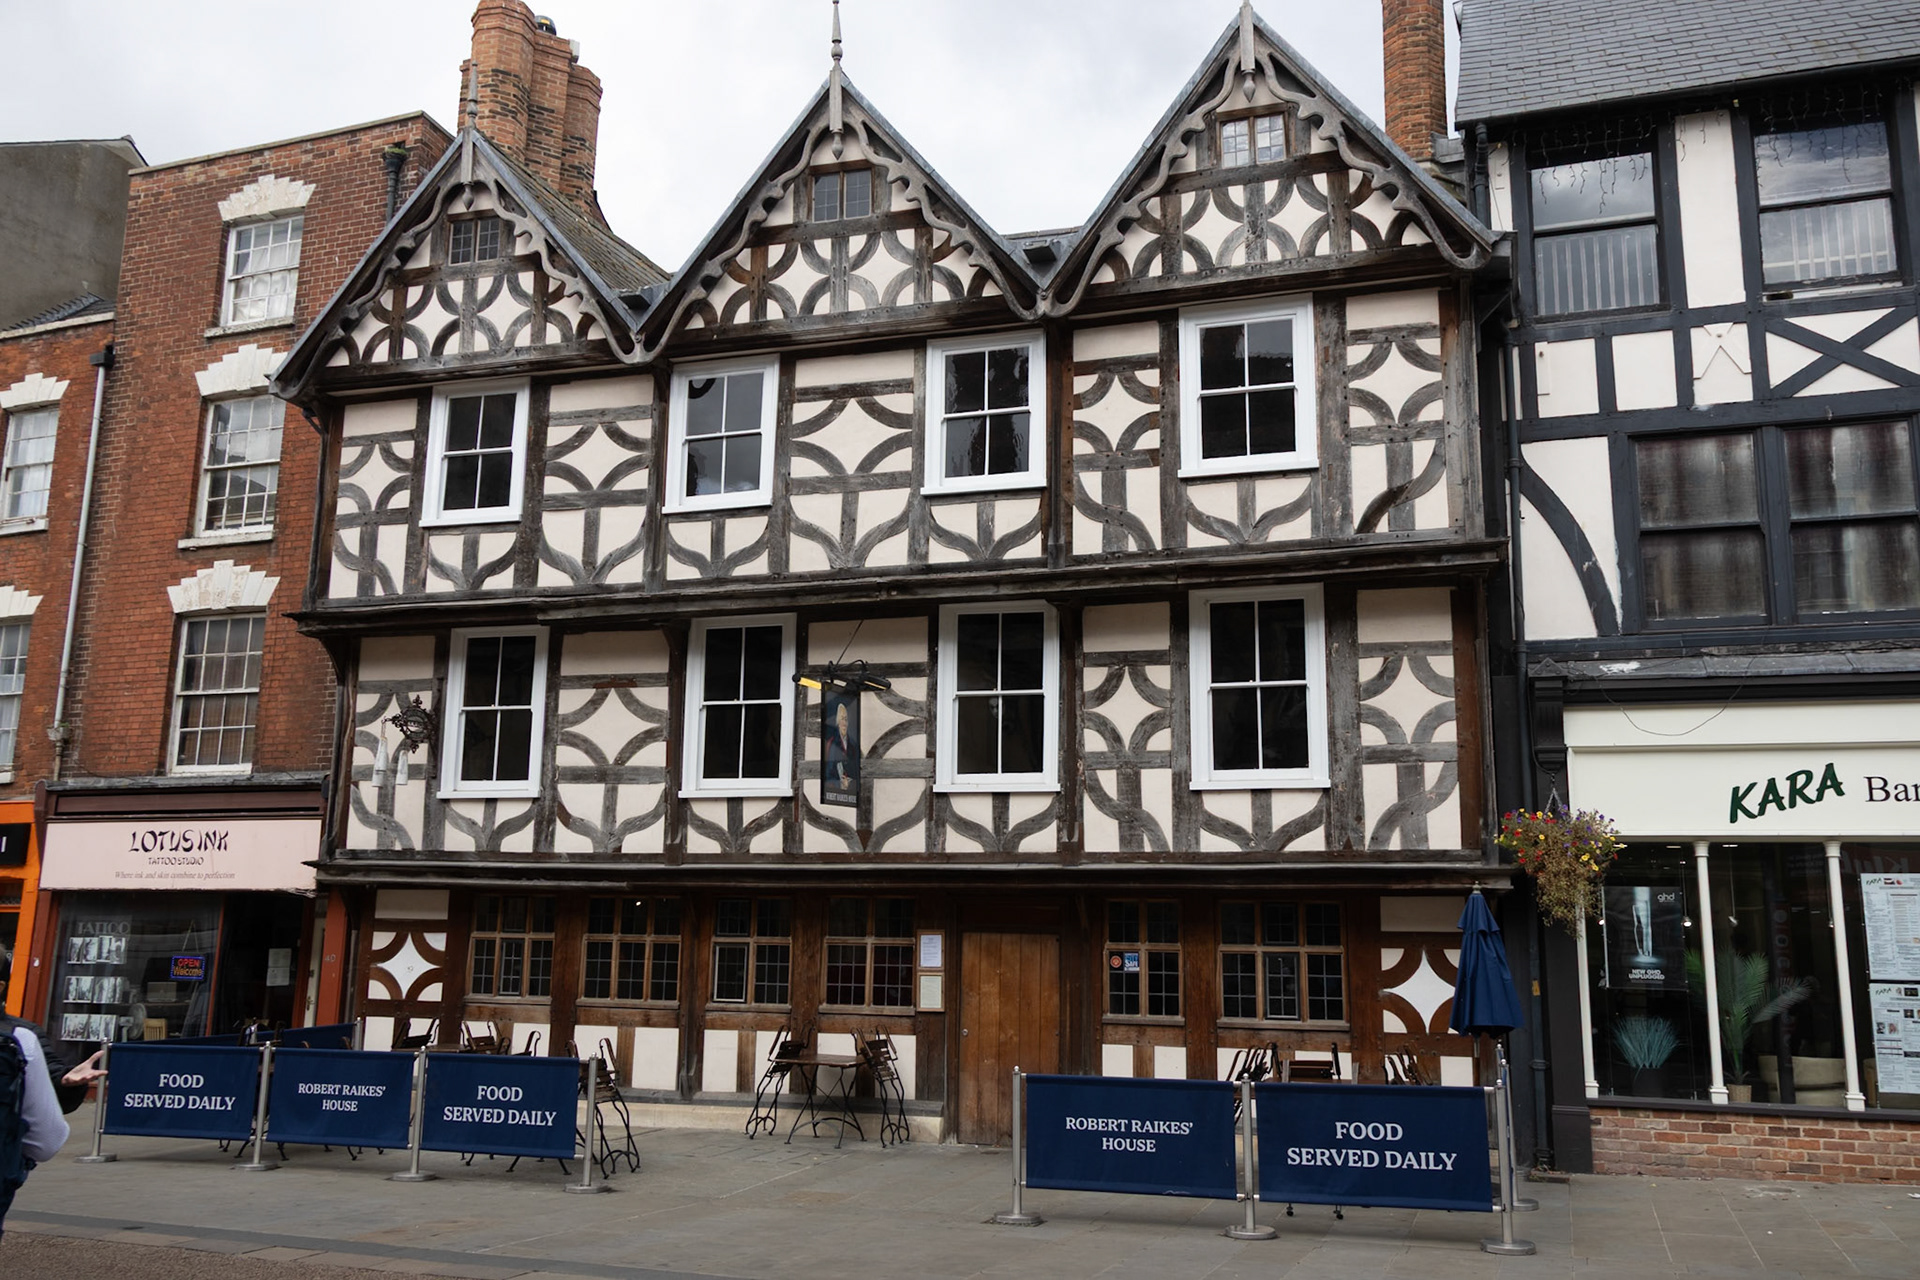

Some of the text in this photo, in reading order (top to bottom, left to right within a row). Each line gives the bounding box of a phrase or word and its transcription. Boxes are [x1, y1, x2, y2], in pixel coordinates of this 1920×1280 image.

[1729, 762, 1846, 824] KARA
[128, 829, 229, 853] LOTUS INK
[148, 857, 204, 866] TATTOO STUDIO
[115, 871, 133, 879] Where
[134, 871, 144, 879] ink
[145, 871, 156, 879] and
[157, 871, 169, 879] skin
[170, 871, 196, 879] combine
[203, 871, 236, 881] perfection
[1657, 893, 1675, 903] ghd
[178, 958, 200, 967] OPEN
[173, 966, 202, 977] Welcome
[159, 1073, 204, 1088] FOOD
[298, 1083, 386, 1098] ROBERT RAIKES’
[477, 1085, 523, 1102] FOOD
[124, 1093, 236, 1111] SERVED DAILY
[322, 1099, 358, 1112] HOUSE
[443, 1107, 557, 1127] SERVED DAILY
[1065, 1117, 1193, 1135] ROBERT RAIKES’
[1335, 1121, 1403, 1141] FOOD
[1102, 1137, 1156, 1152] HOUSE
[1287, 1147, 1457, 1171] SERVED DAILY
